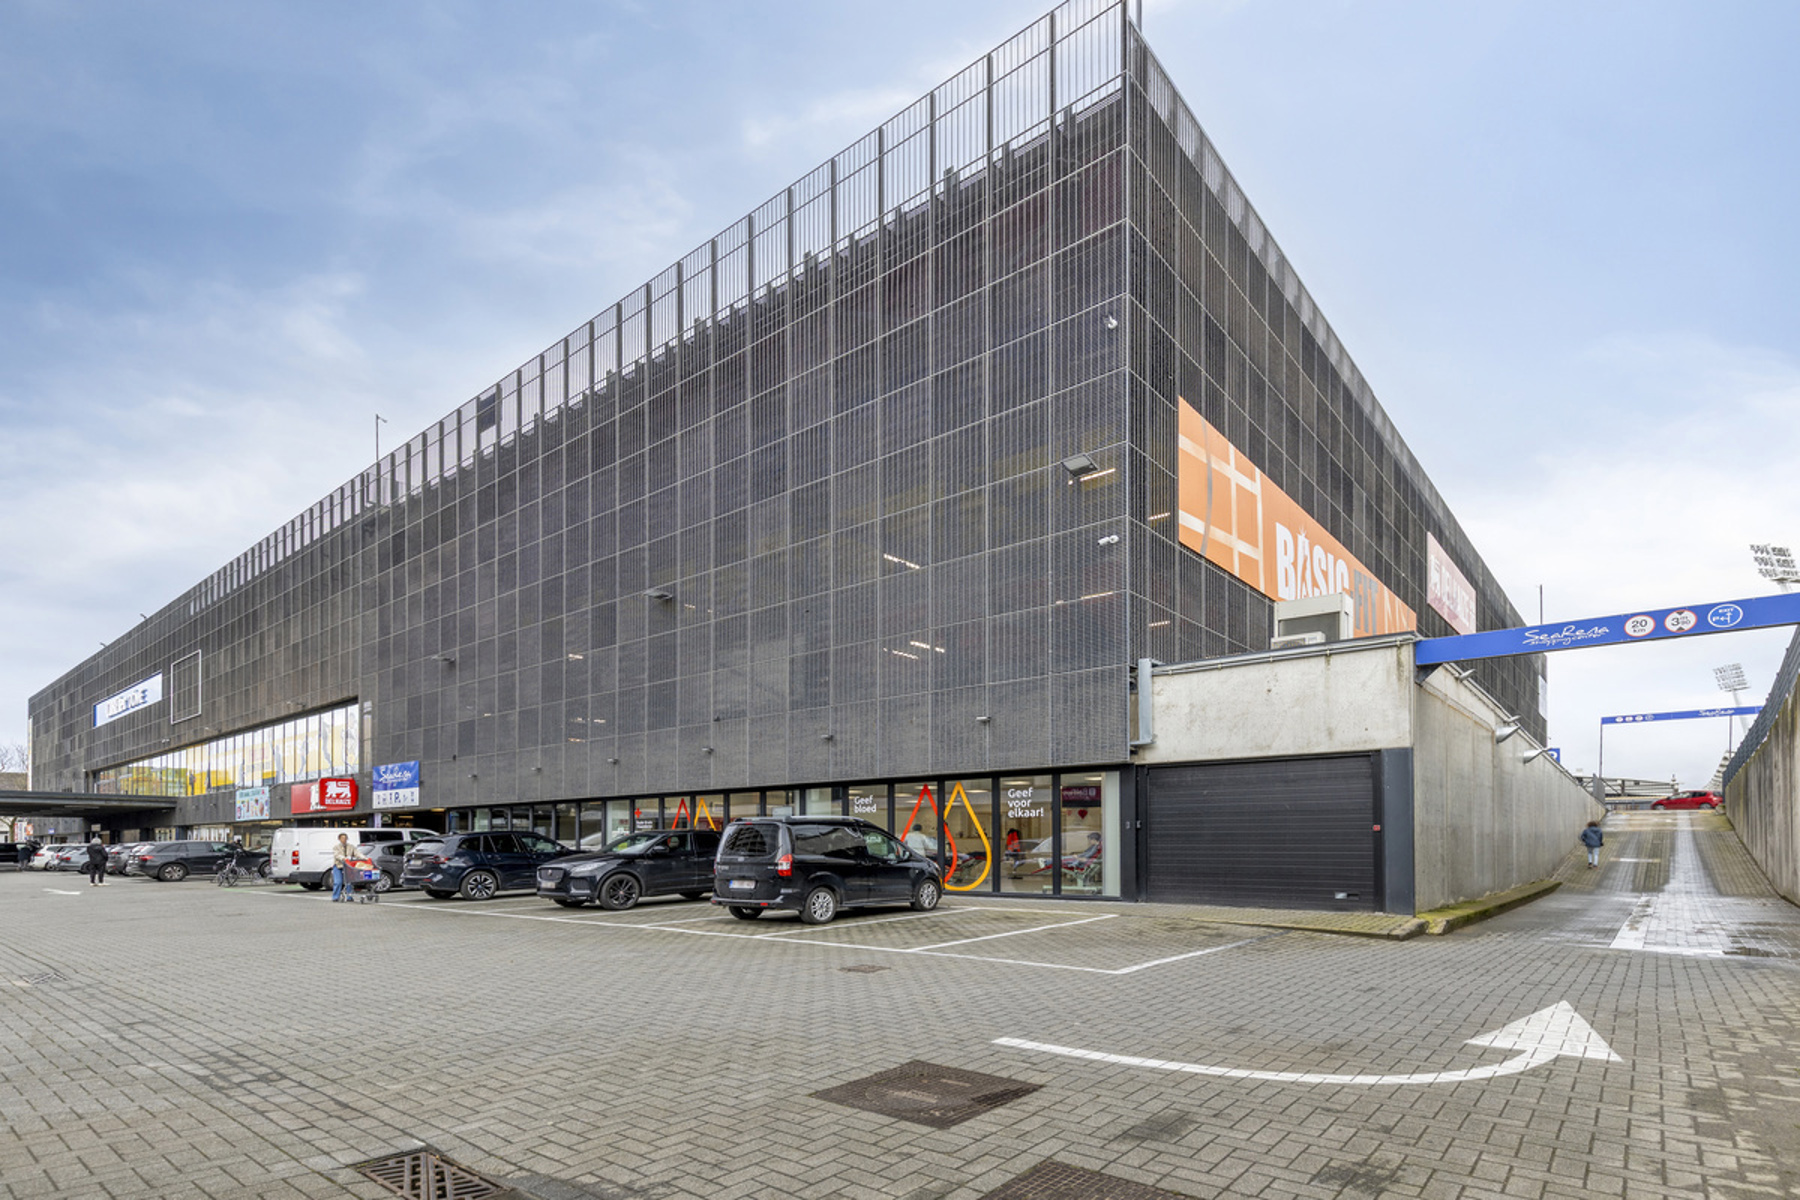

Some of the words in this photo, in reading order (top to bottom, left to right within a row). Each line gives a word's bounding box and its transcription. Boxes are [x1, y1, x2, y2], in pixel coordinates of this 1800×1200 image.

[1631, 619, 1648, 629] 20
[1671, 617, 1680, 626] 3
[1007, 787, 1033, 798] Geef
[854, 795, 873, 804] Geef
[1007, 799, 1032, 808] voor
[854, 804, 877, 813] bloed
[1007, 807, 1044, 818] elkaar!
